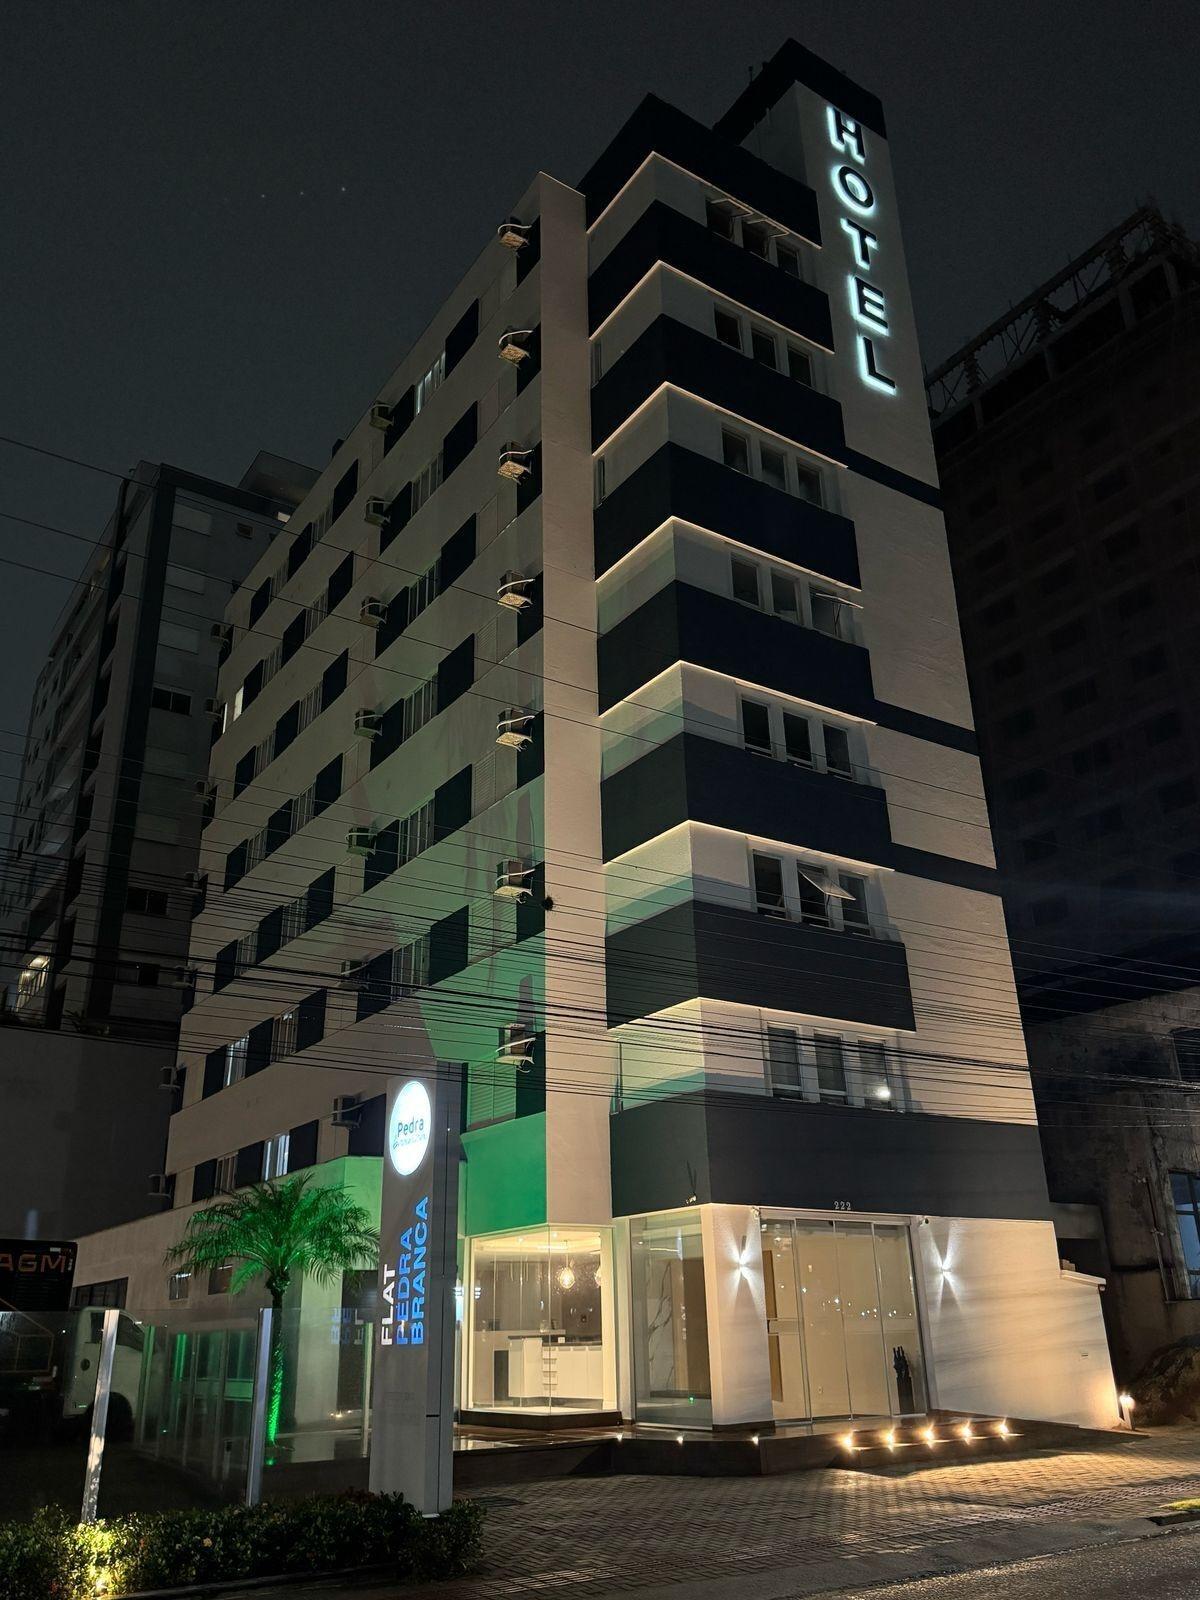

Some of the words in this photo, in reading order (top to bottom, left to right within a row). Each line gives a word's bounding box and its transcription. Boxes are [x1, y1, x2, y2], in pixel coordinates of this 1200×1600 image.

[826, 105, 897, 396] HOTEL
[397, 1115, 425, 1138] Pedra
[833, 1200, 852, 1211] 222
[381, 1264, 396, 1345] FLAT
[396, 1226, 413, 1345] PEDRA
[410, 1196, 429, 1345] BRANCA
